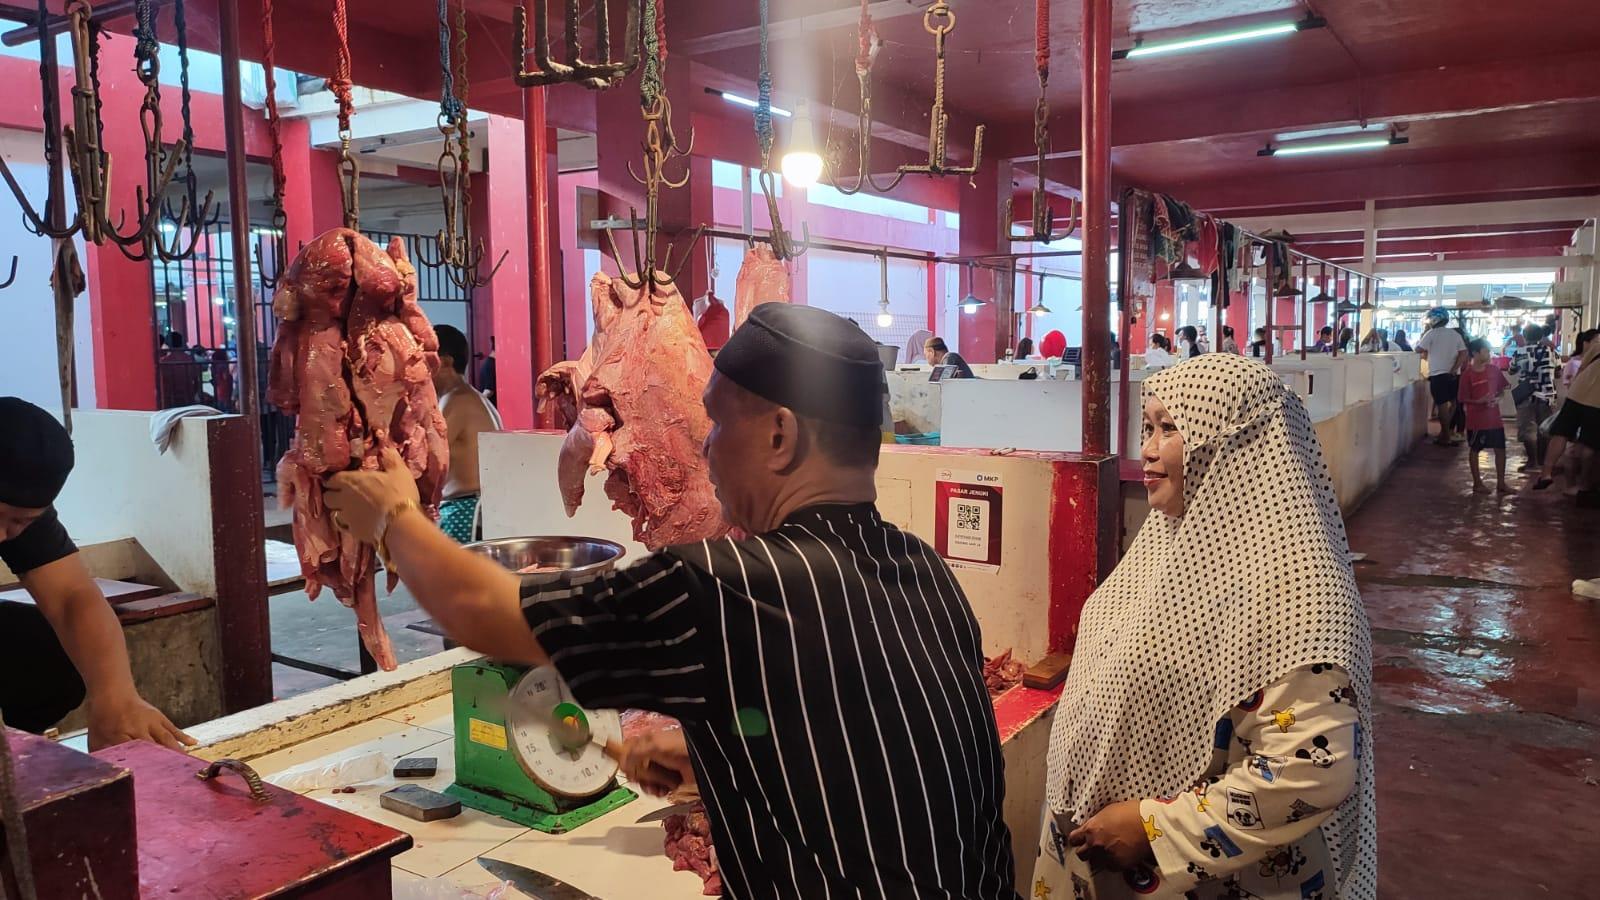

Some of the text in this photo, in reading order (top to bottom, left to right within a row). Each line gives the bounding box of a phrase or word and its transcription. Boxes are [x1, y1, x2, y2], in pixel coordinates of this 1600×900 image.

[950, 487, 968, 495] PASAR
[525, 743, 537, 755] 15
[581, 767, 592, 778] 10
